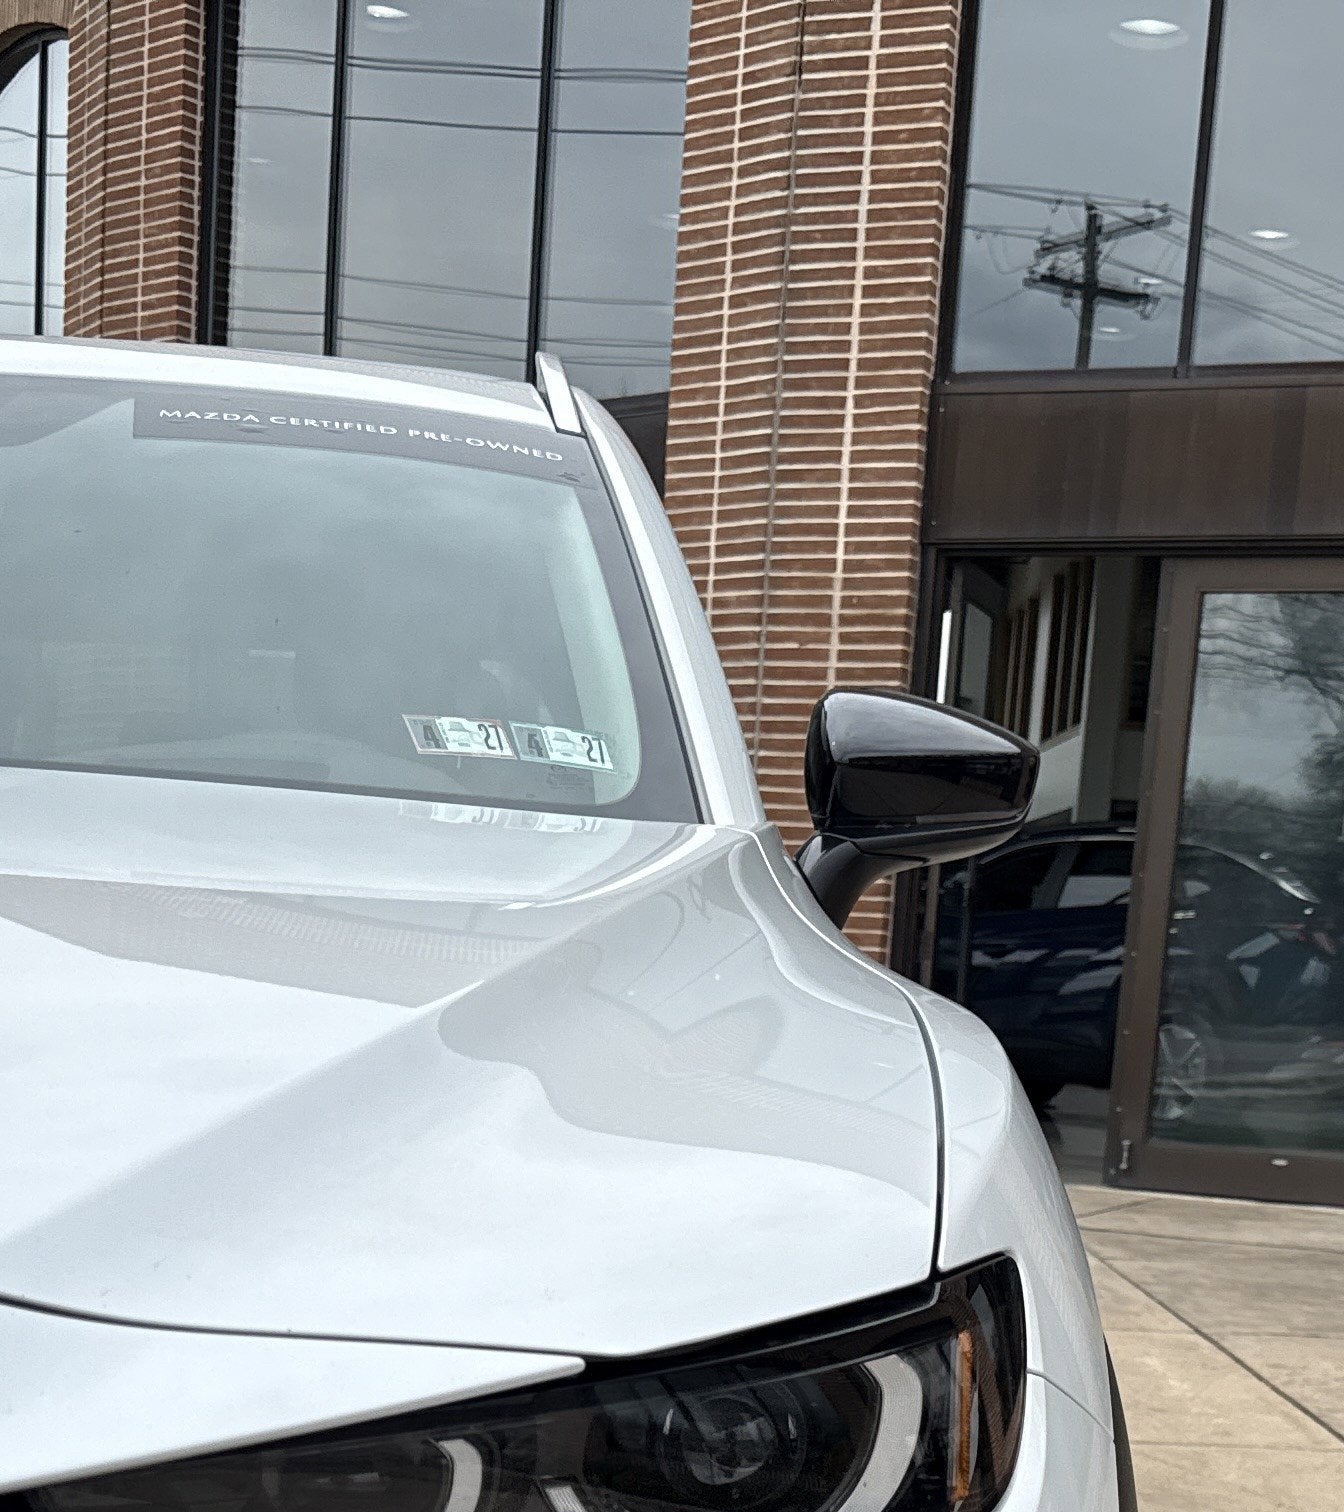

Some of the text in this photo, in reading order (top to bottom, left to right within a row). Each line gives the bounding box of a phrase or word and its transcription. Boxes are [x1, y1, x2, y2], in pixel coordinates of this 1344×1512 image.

[159, 409, 563, 461] MAZDA CERTIFIED PRE-OWNED
[422, 724, 442, 749] 4
[477, 723, 504, 752] 27
[581, 735, 605, 765] 27
